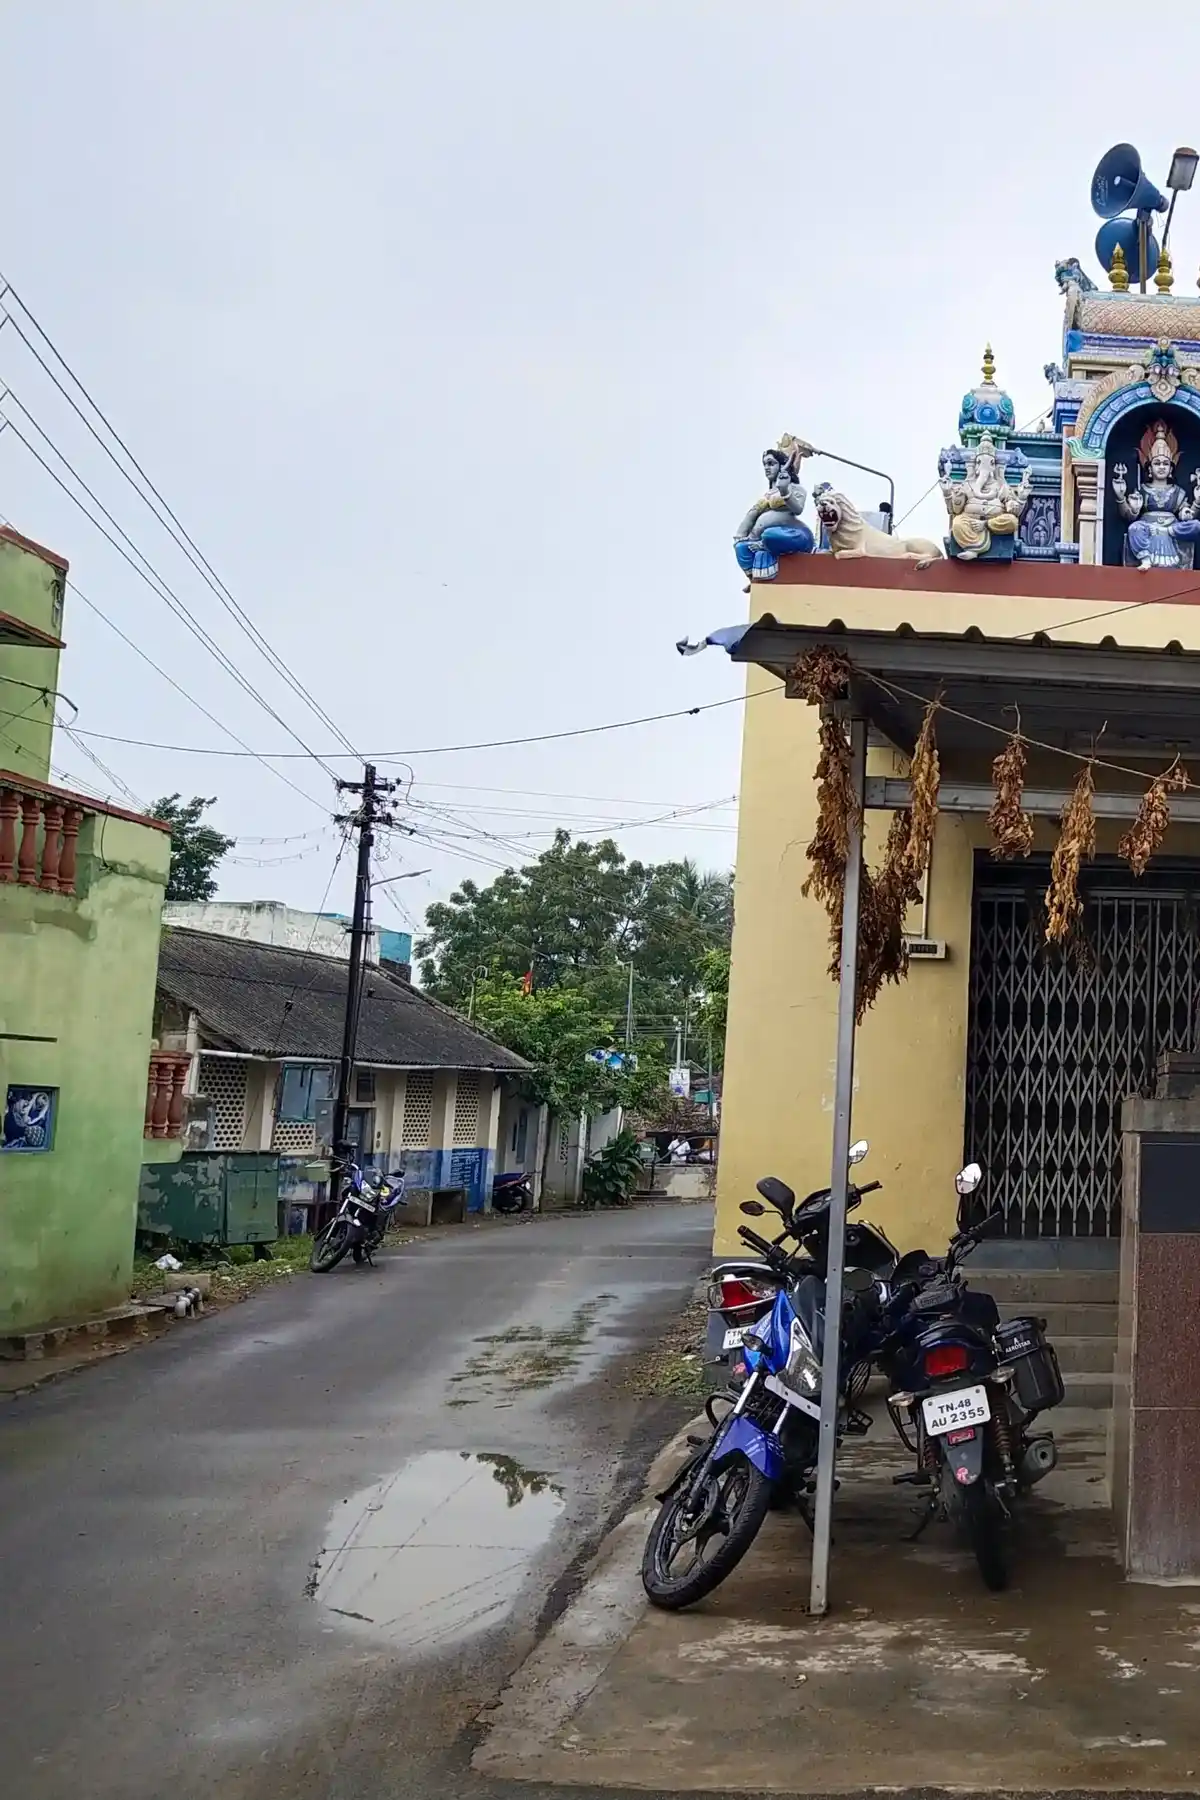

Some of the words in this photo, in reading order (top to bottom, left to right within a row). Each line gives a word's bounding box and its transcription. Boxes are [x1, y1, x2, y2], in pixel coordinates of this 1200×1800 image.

[1005, 1340, 1031, 1353] AEROSTAR
[938, 1398, 971, 1414] TN.48
[931, 1417, 947, 1428] AU
[950, 1406, 985, 1424] 2355
